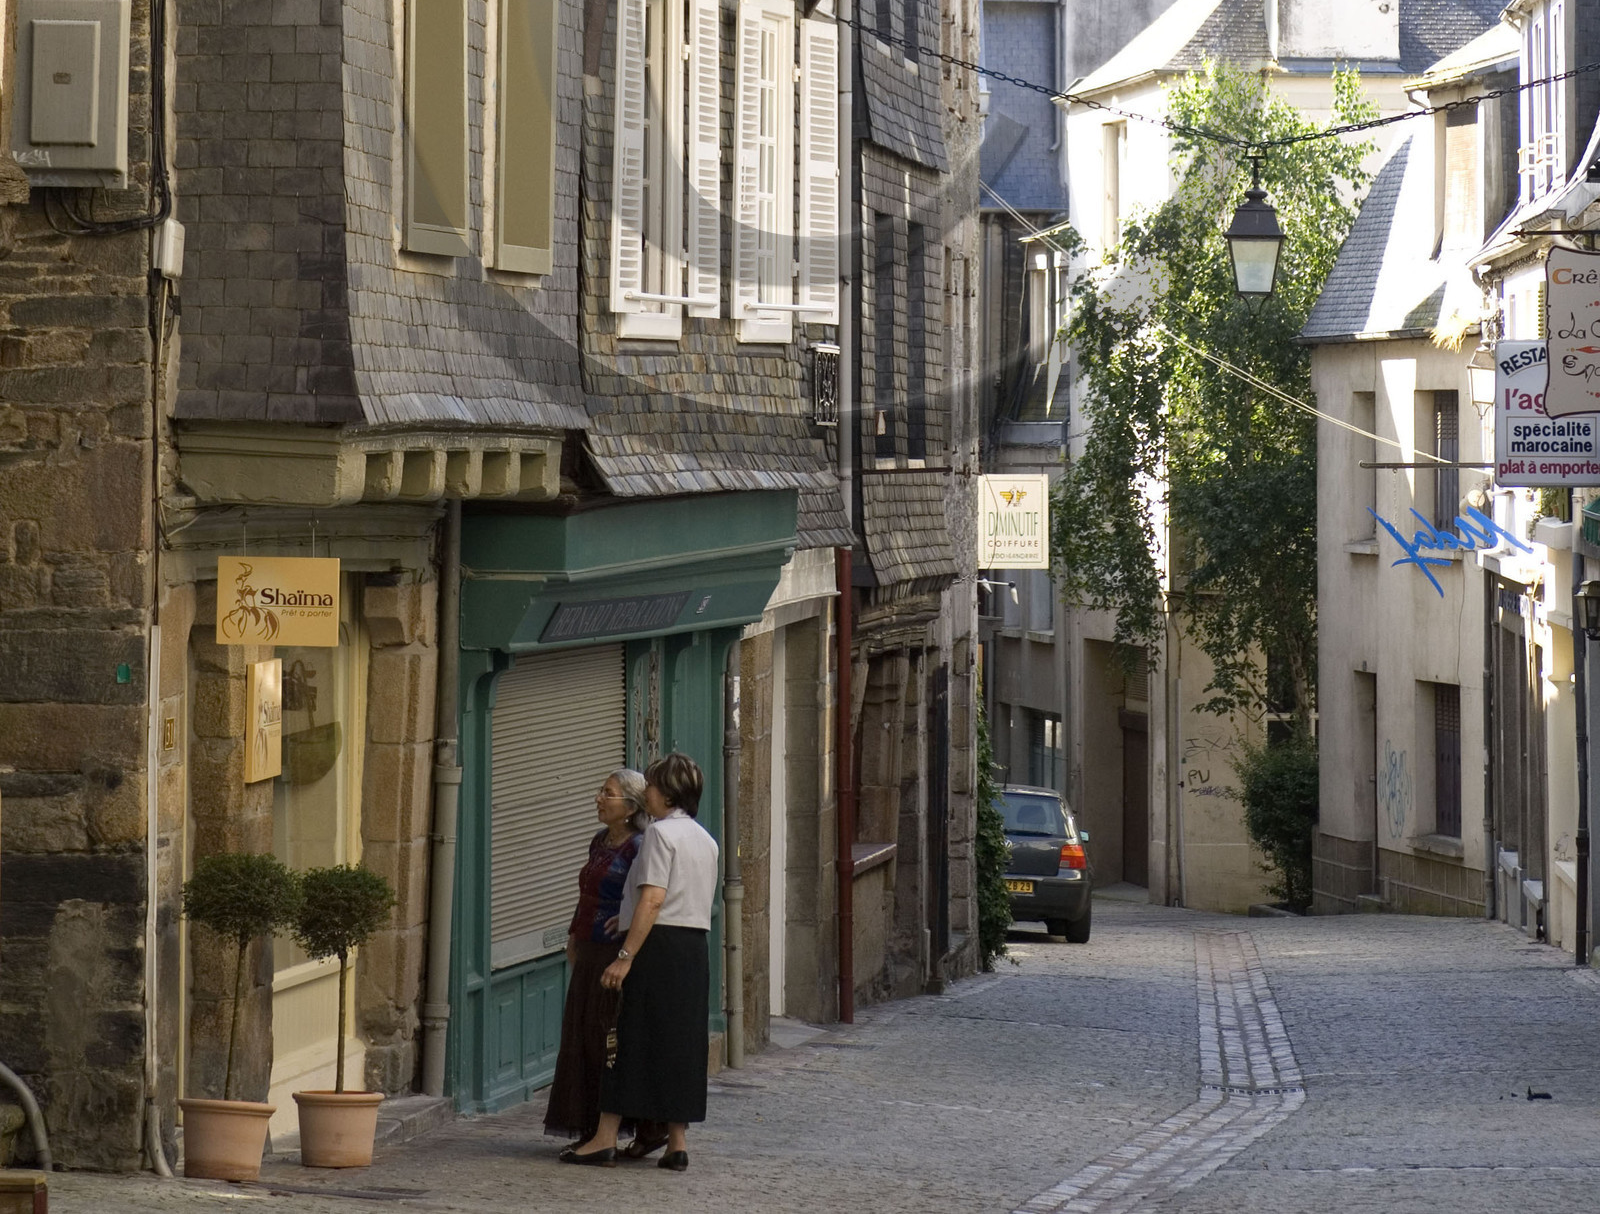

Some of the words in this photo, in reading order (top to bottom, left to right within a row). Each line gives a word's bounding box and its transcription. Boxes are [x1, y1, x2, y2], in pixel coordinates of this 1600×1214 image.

[1511, 438, 1593, 453] marocaine
[1499, 459, 1525, 478] plat
[1528, 460, 1537, 474] à
[988, 511, 1038, 536] DIMINUTIF
[260, 588, 333, 606] Shaïma
